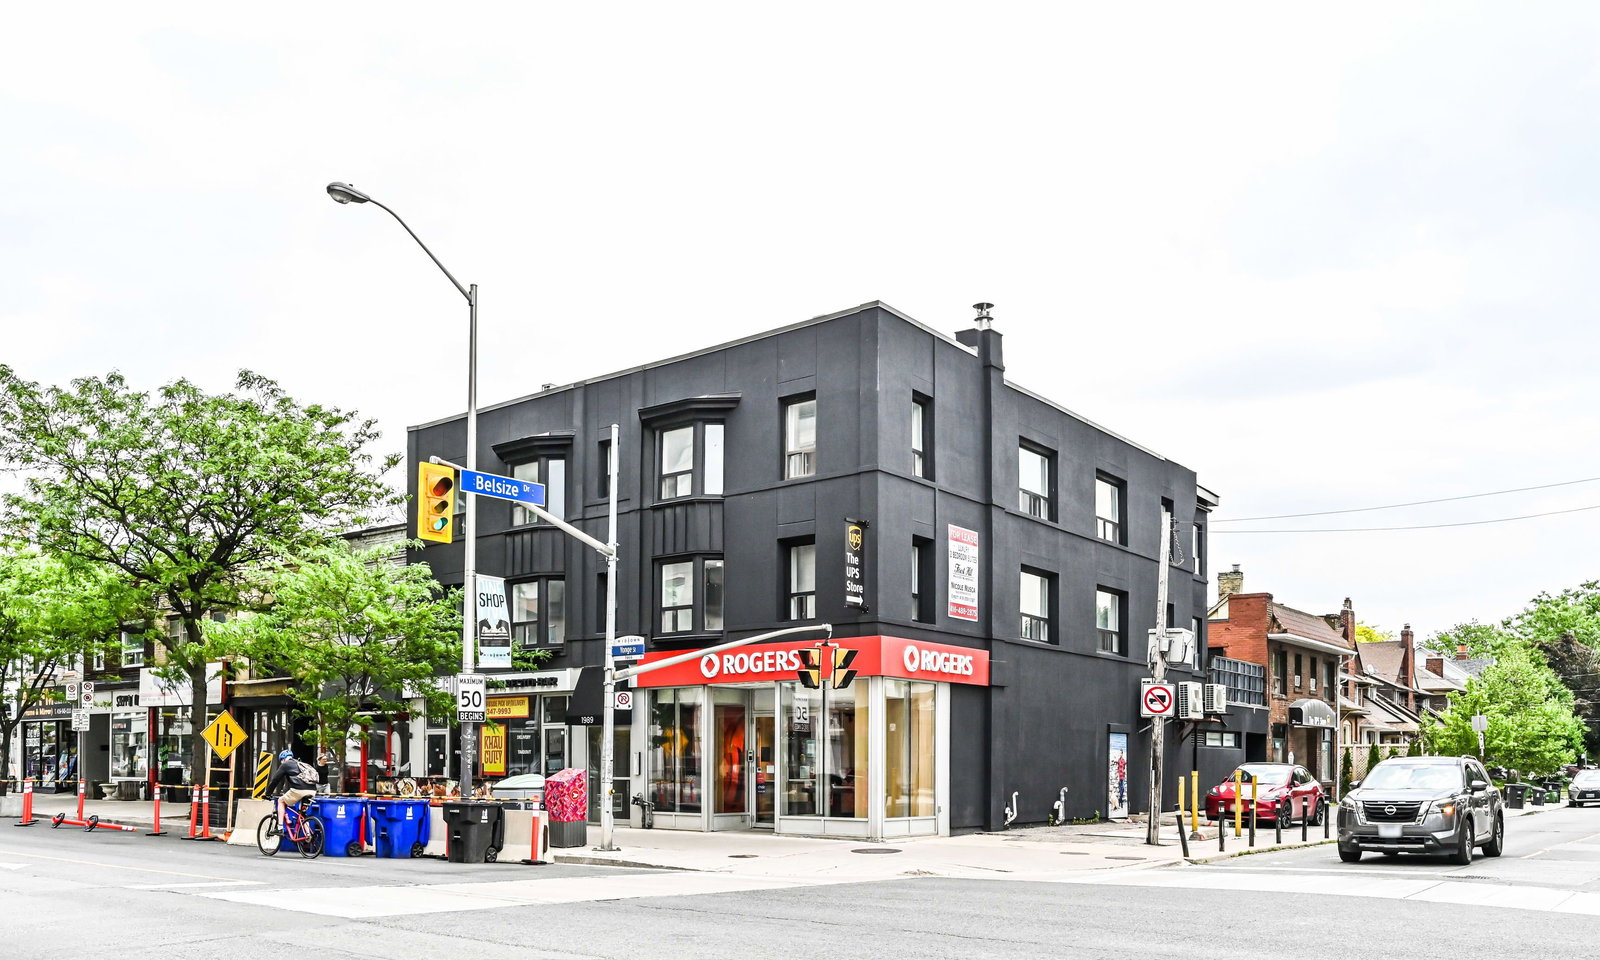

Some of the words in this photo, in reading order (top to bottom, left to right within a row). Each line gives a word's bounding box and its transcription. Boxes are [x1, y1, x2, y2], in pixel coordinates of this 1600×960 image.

[476, 475, 519, 497] Belsize
[523, 484, 531, 493] Dr
[849, 533, 861, 547] ups
[961, 532, 977, 544] LEASE
[846, 552, 859, 565] The
[846, 566, 860, 579] UPS
[846, 580, 864, 593] Store
[950, 582, 964, 591] NICOLE
[479, 593, 505, 608] SHOP
[620, 646, 632, 654] Yonge
[723, 650, 801, 675] ROGERS
[920, 650, 973, 676] ROGERS
[461, 690, 482, 708] 50
[460, 712, 484, 720] BEGINS
[581, 716, 594, 724] 1989
[484, 735, 503, 749] KHAU
[484, 750, 503, 764] GULLY
